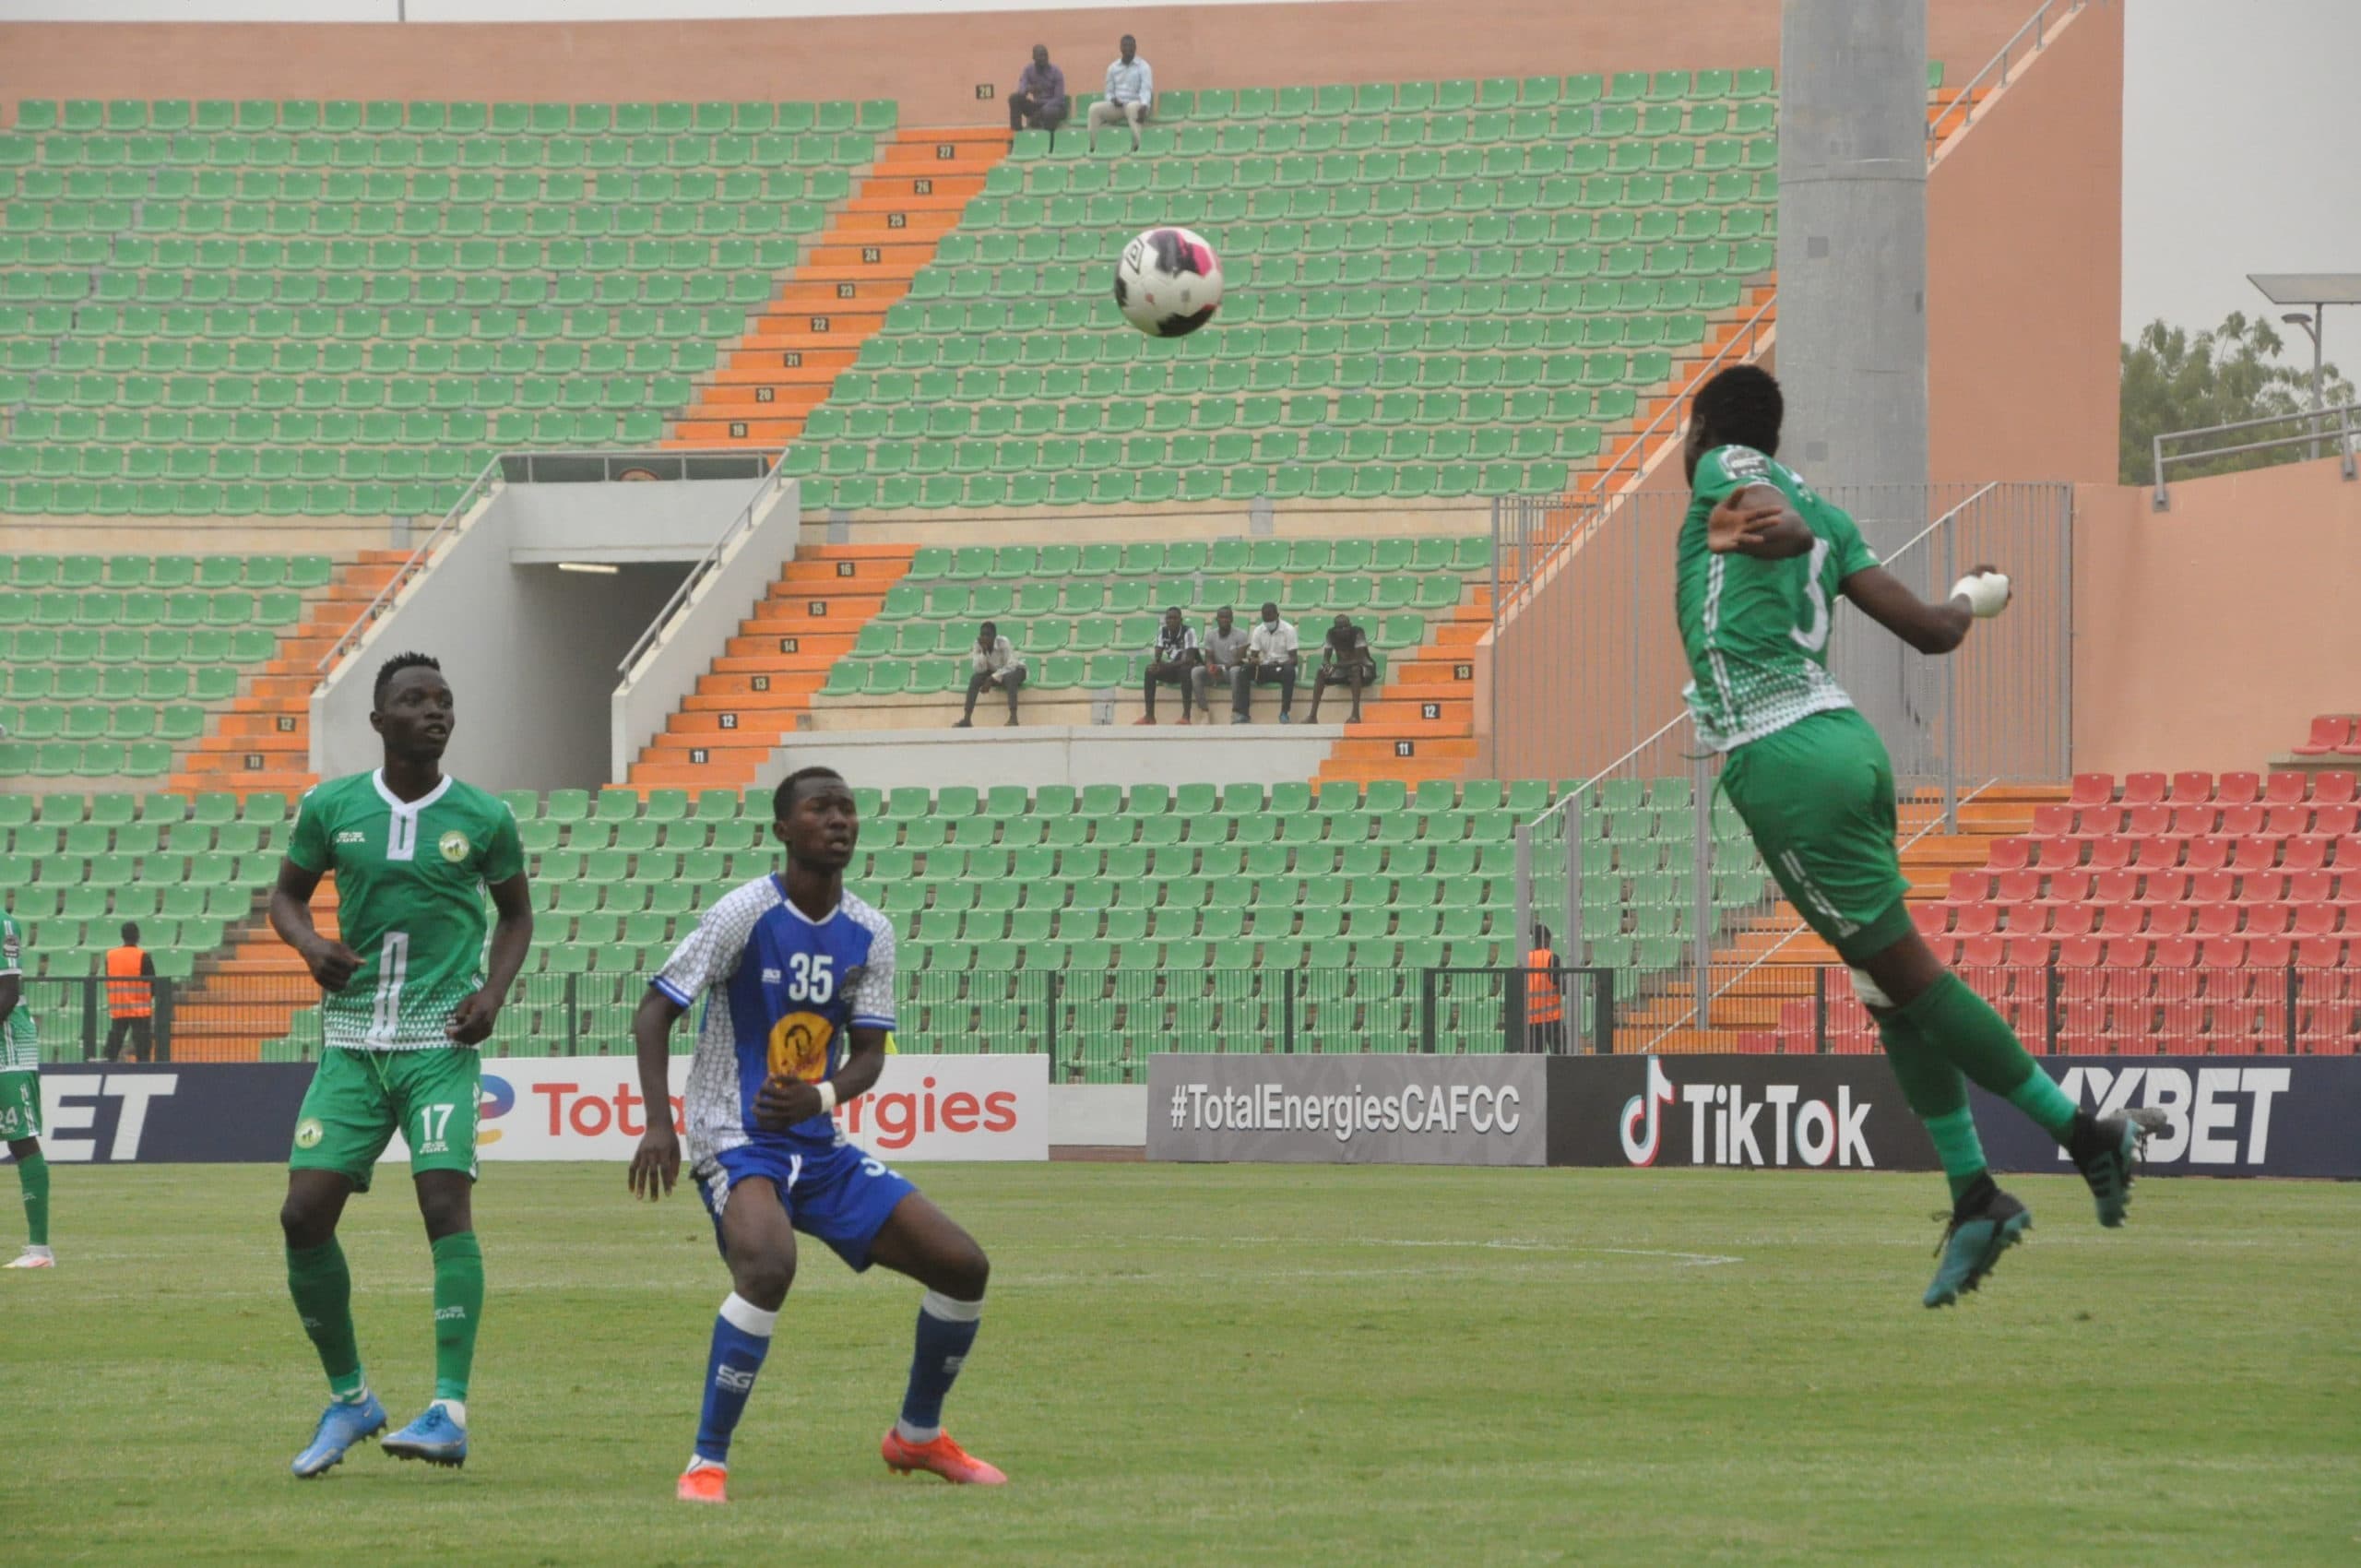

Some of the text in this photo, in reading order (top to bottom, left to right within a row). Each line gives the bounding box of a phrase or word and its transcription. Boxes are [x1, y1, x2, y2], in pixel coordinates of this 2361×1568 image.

[940, 147, 951, 159] 27
[865, 249, 878, 262] 24
[840, 285, 854, 298] 23
[813, 318, 826, 331] 22
[787, 354, 799, 367] 21
[840, 564, 852, 576] 16
[812, 603, 824, 615] 15
[784, 640, 795, 652] 14
[1457, 666, 1469, 679] 13
[754, 677, 766, 690] 13
[1424, 705, 1436, 719] 12
[280, 719, 292, 731] 12
[722, 715, 734, 728] 12
[1398, 742, 1409, 755] 11
[249, 756, 260, 768] 11
[694, 751, 705, 763] 11
[789, 953, 834, 1004] 35
[1170, 1084, 1520, 1142] #TotalEnergiesCAFCC
[421, 1104, 455, 1141] 17
[1683, 1084, 1875, 1167] TikTok
